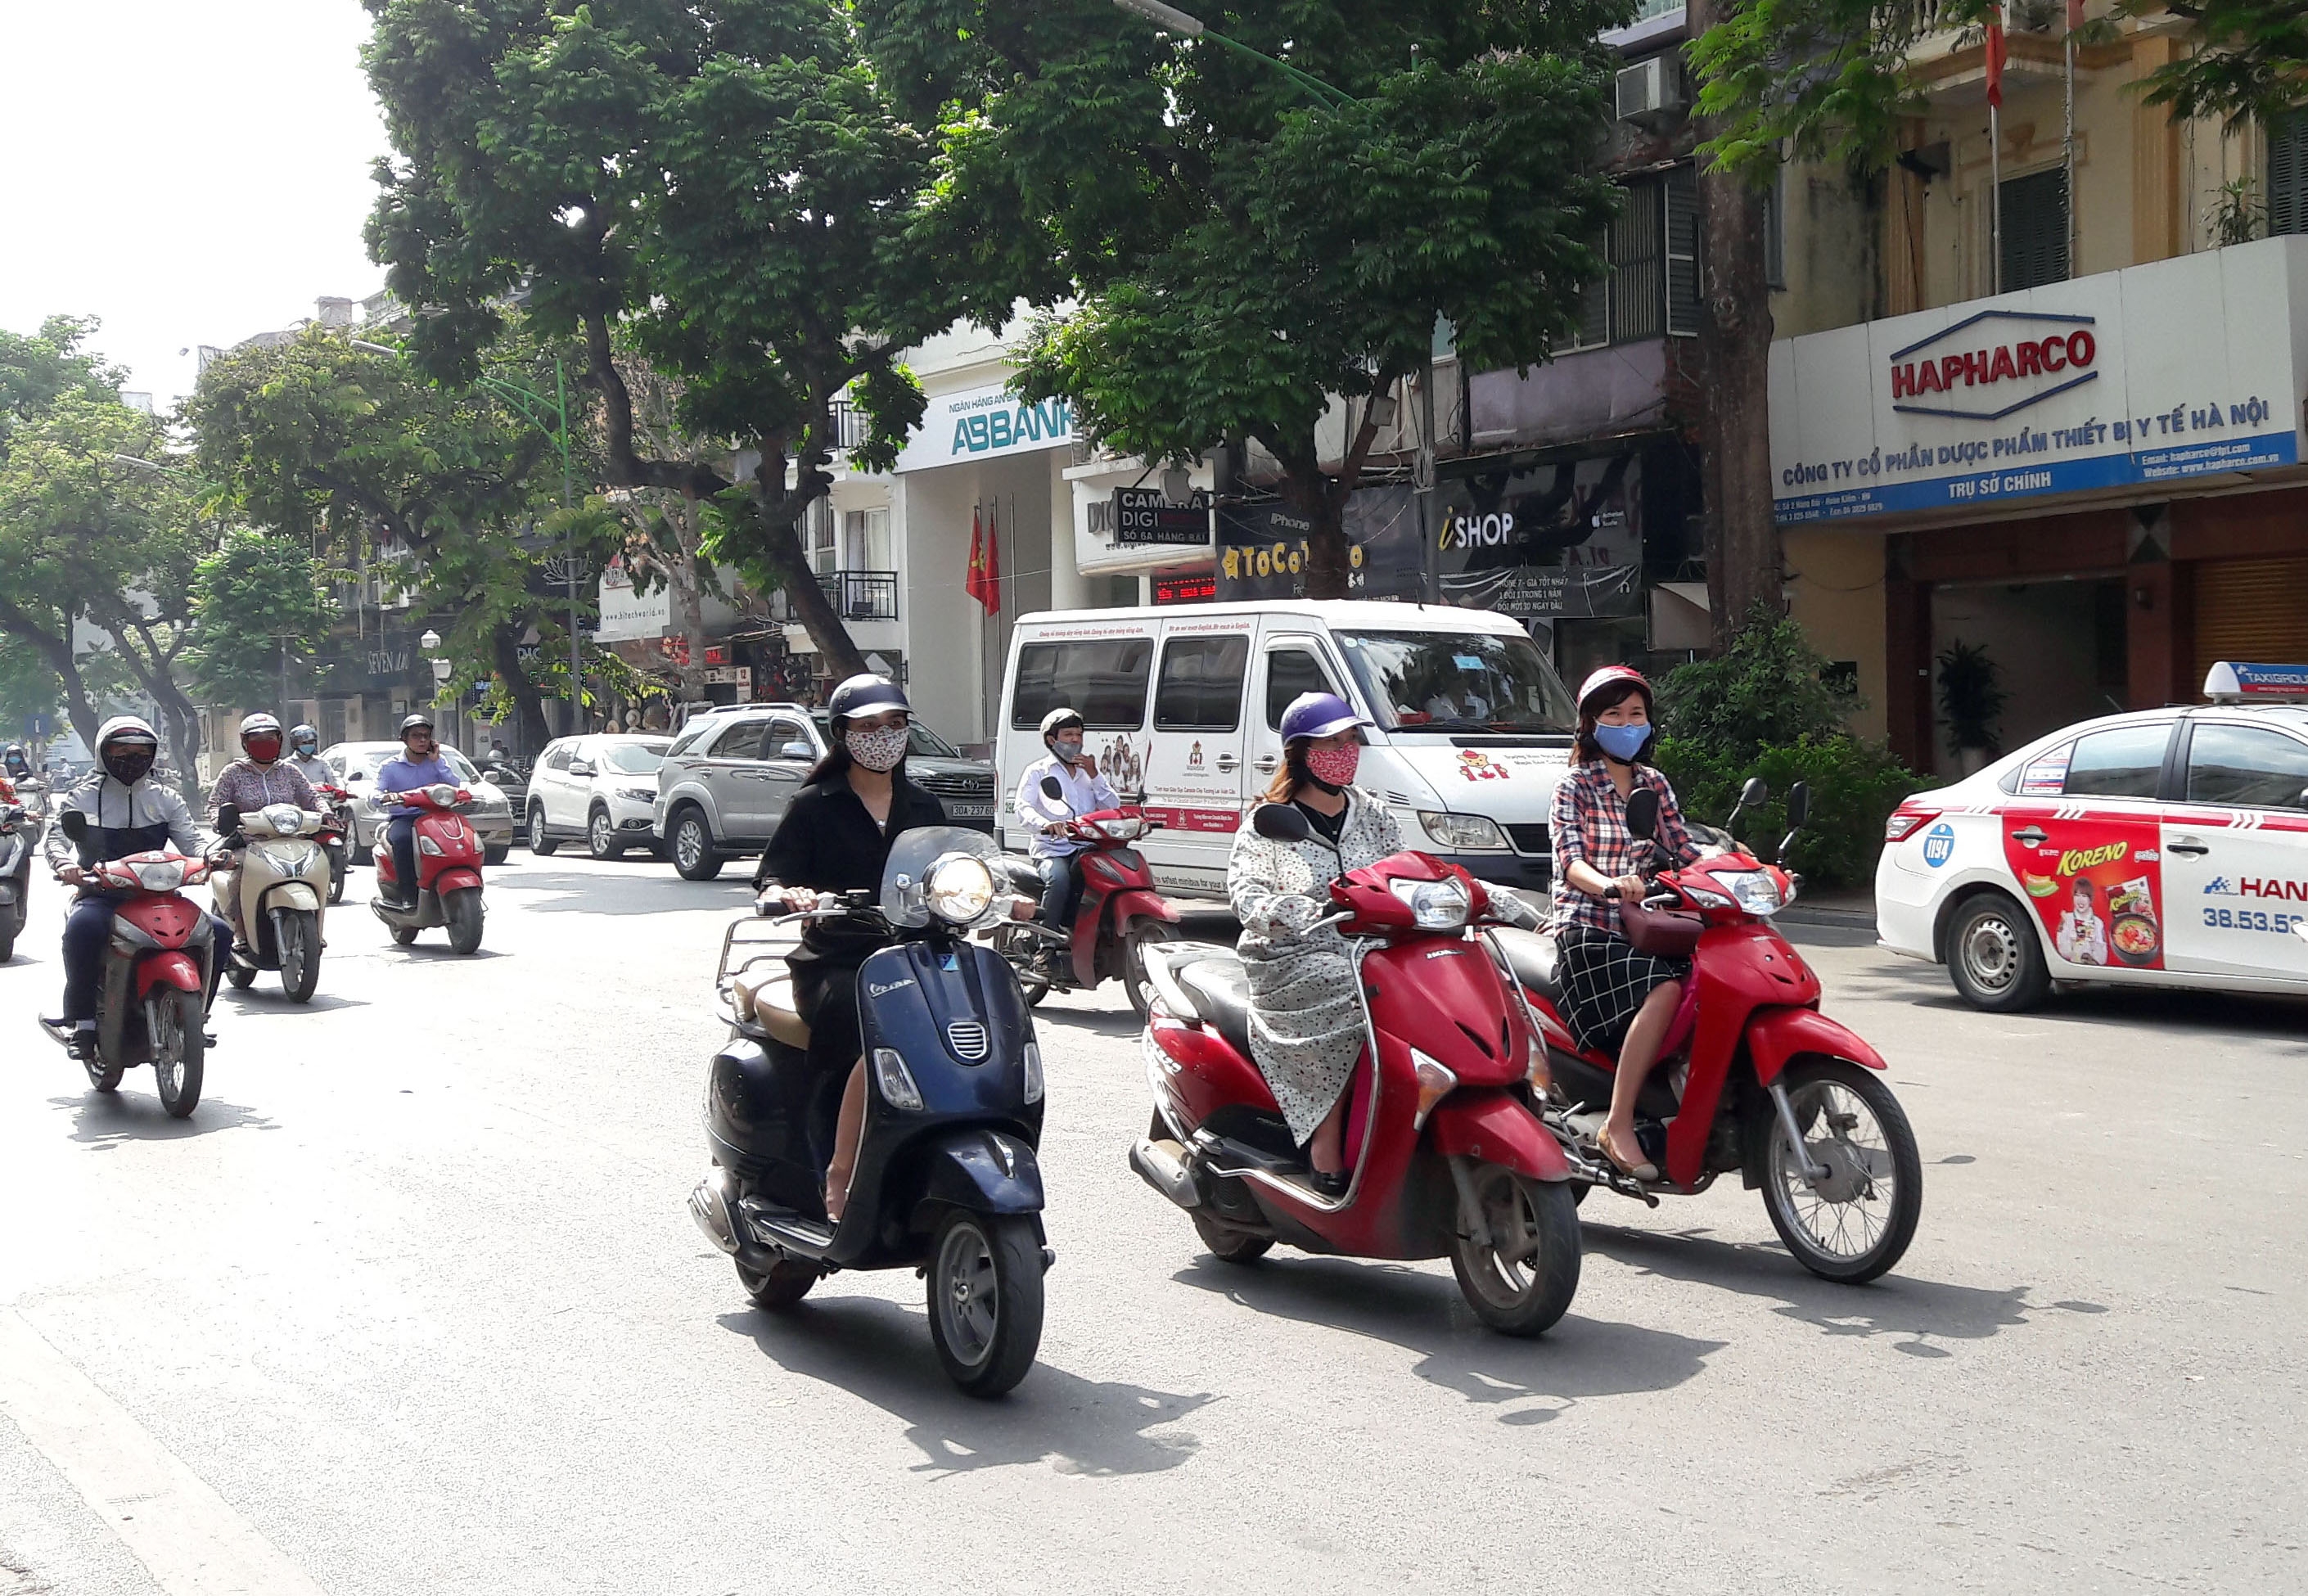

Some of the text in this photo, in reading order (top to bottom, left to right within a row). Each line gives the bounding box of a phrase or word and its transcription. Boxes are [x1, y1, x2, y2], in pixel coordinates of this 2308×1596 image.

[1891, 330, 2096, 399] HAPHARCO
[994, 394, 1006, 404] AN
[952, 399, 1072, 455] ABBANK
[1783, 462, 1828, 485] CÔNG
[1832, 460, 1852, 479] TY
[1857, 446, 1881, 476] CỔ
[1885, 443, 1933, 472] PHẦN
[1938, 441, 1987, 466] DƯỢC
[1992, 426, 2048, 457] PHẨM
[2053, 417, 2107, 449] THIẾT
[2136, 417, 2151, 437] Y
[2157, 403, 2185, 434] TẾ
[2191, 403, 2225, 430] HÀ
[2230, 396, 2270, 426] NỘI
[2142, 453, 2169, 466] Email:
[2143, 453, 2279, 477] Website: www.hapharco.com.vn
[1949, 471, 2052, 499] TRỤ SỞ CHÍNH
[1122, 493, 1203, 509] CAMA
[1122, 511, 1159, 527] DIGI
[1141, 532, 1153, 540] 6A
[1927, 839, 1950, 859] 1194
[2056, 841, 2128, 877] KORENO
[2240, 877, 2308, 901] HAN
[870, 979, 915, 998] Vespa
